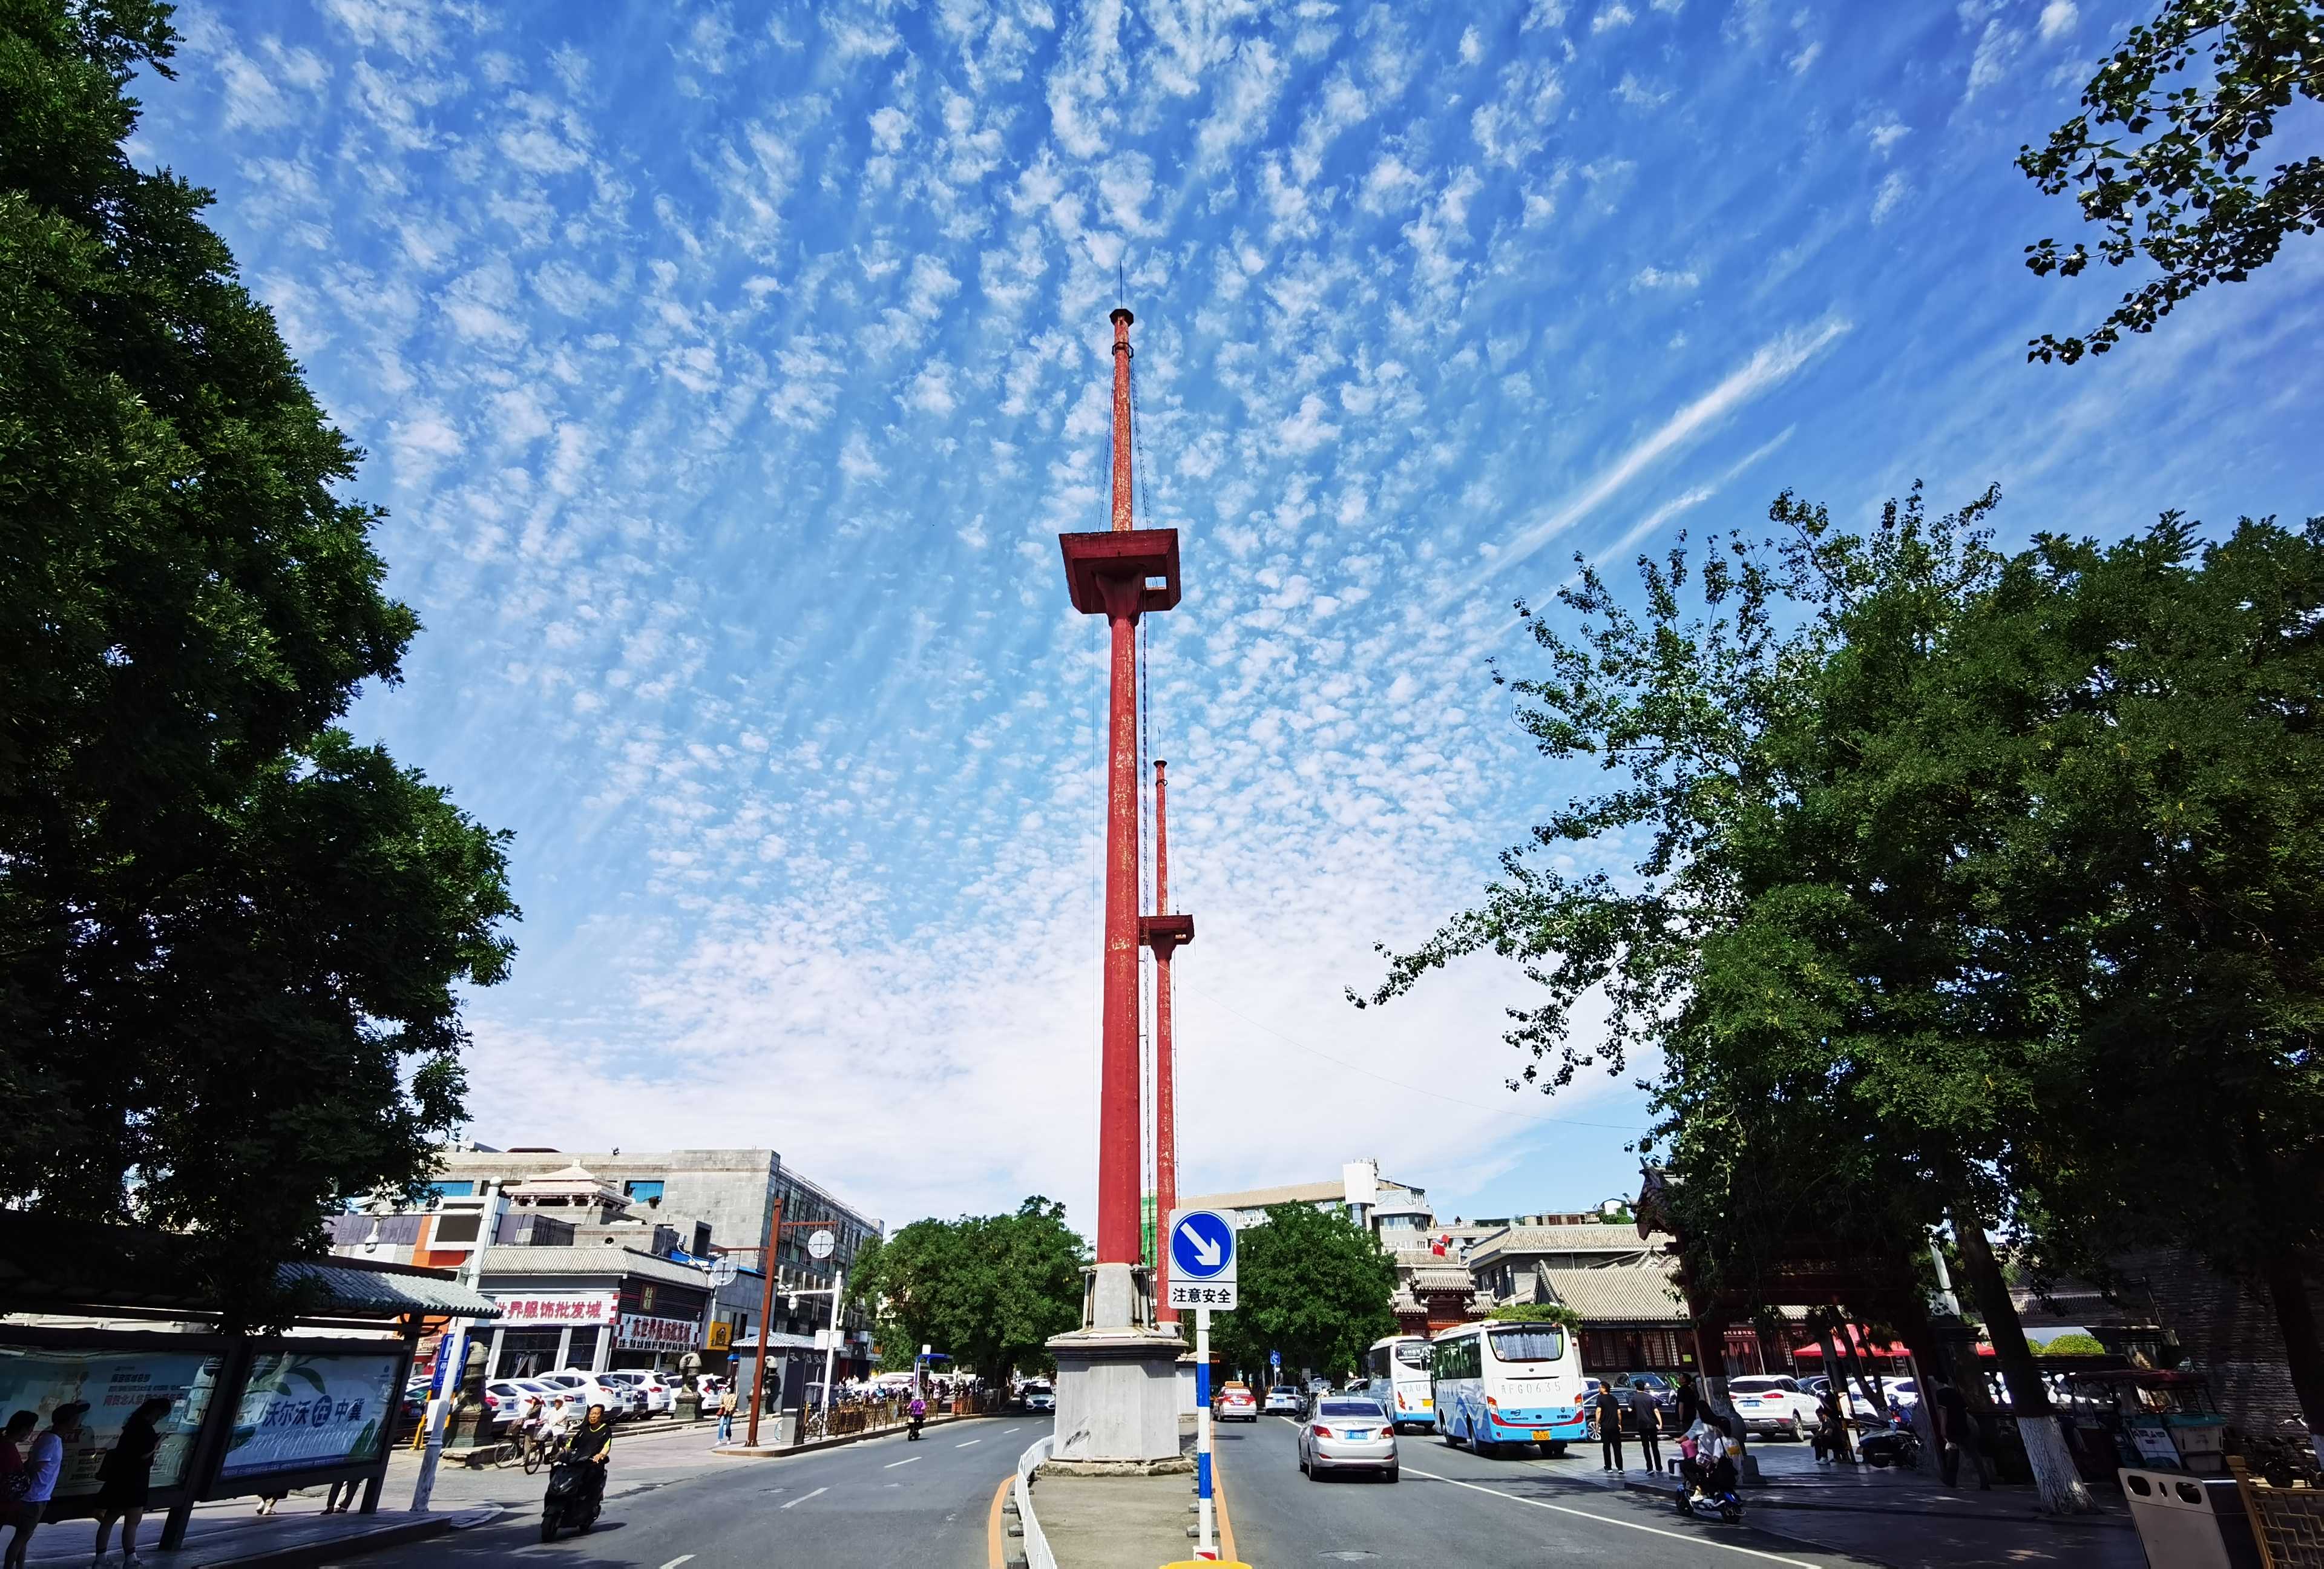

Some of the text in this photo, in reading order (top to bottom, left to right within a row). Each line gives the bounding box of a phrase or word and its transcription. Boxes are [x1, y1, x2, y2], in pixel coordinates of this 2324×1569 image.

[1173, 1288, 1231, 1303] 注意安全
[261, 1395, 364, 1427] 沃尔沃在中冀
